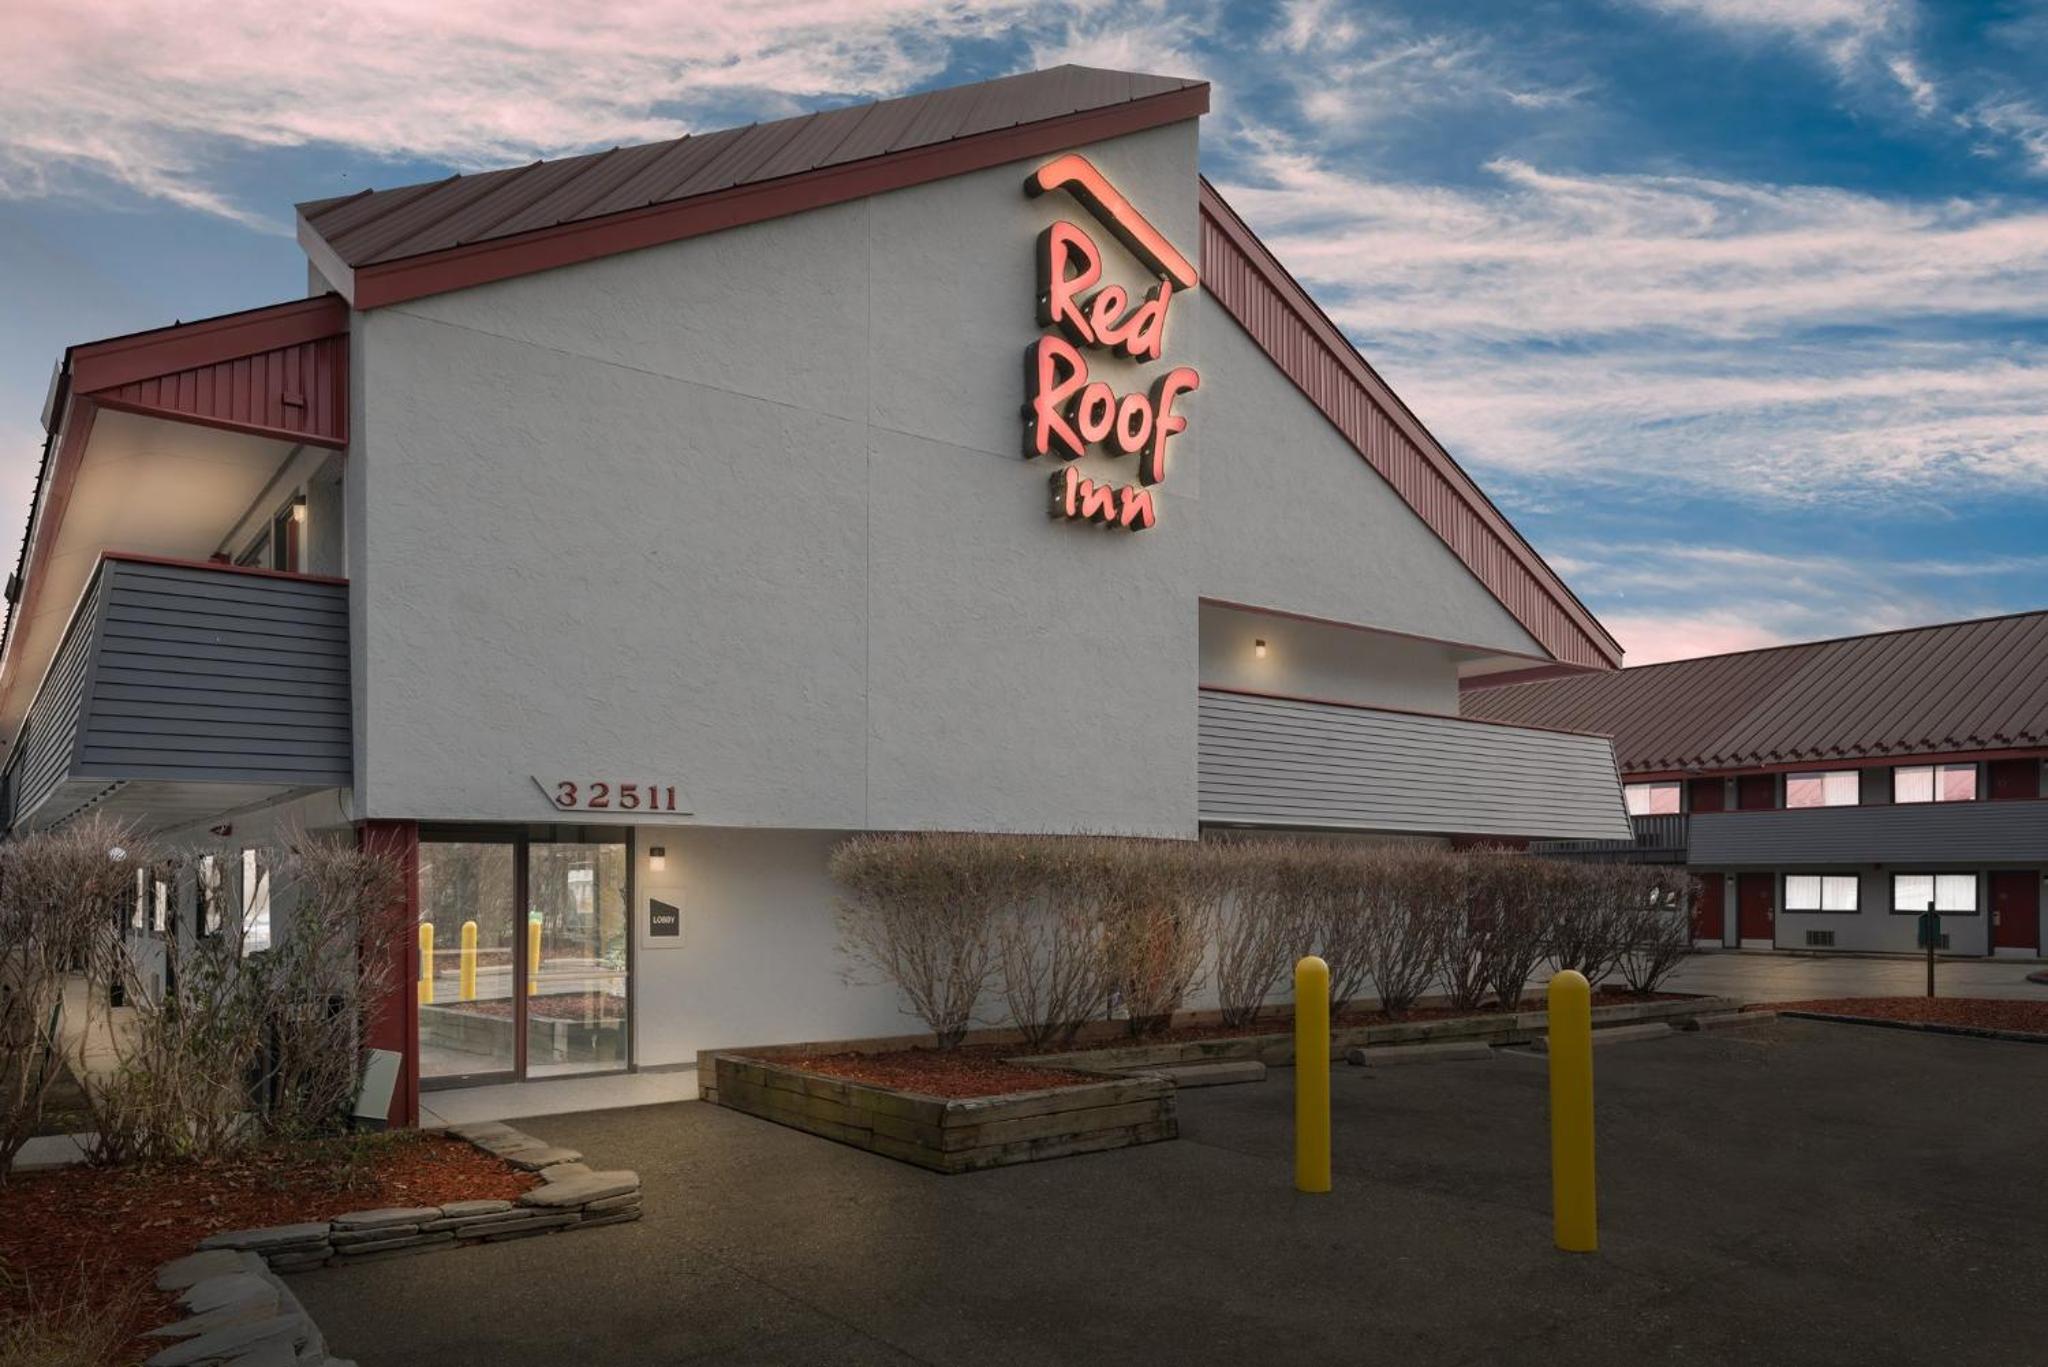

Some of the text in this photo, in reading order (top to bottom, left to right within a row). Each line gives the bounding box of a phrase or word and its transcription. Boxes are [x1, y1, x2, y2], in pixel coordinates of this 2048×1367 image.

[1047, 220, 1173, 361] Red
[1031, 334, 1200, 484] Roof
[1061, 465, 1155, 529] Inn
[555, 781, 676, 811] 32511
[652, 916, 676, 924] LOBBY
